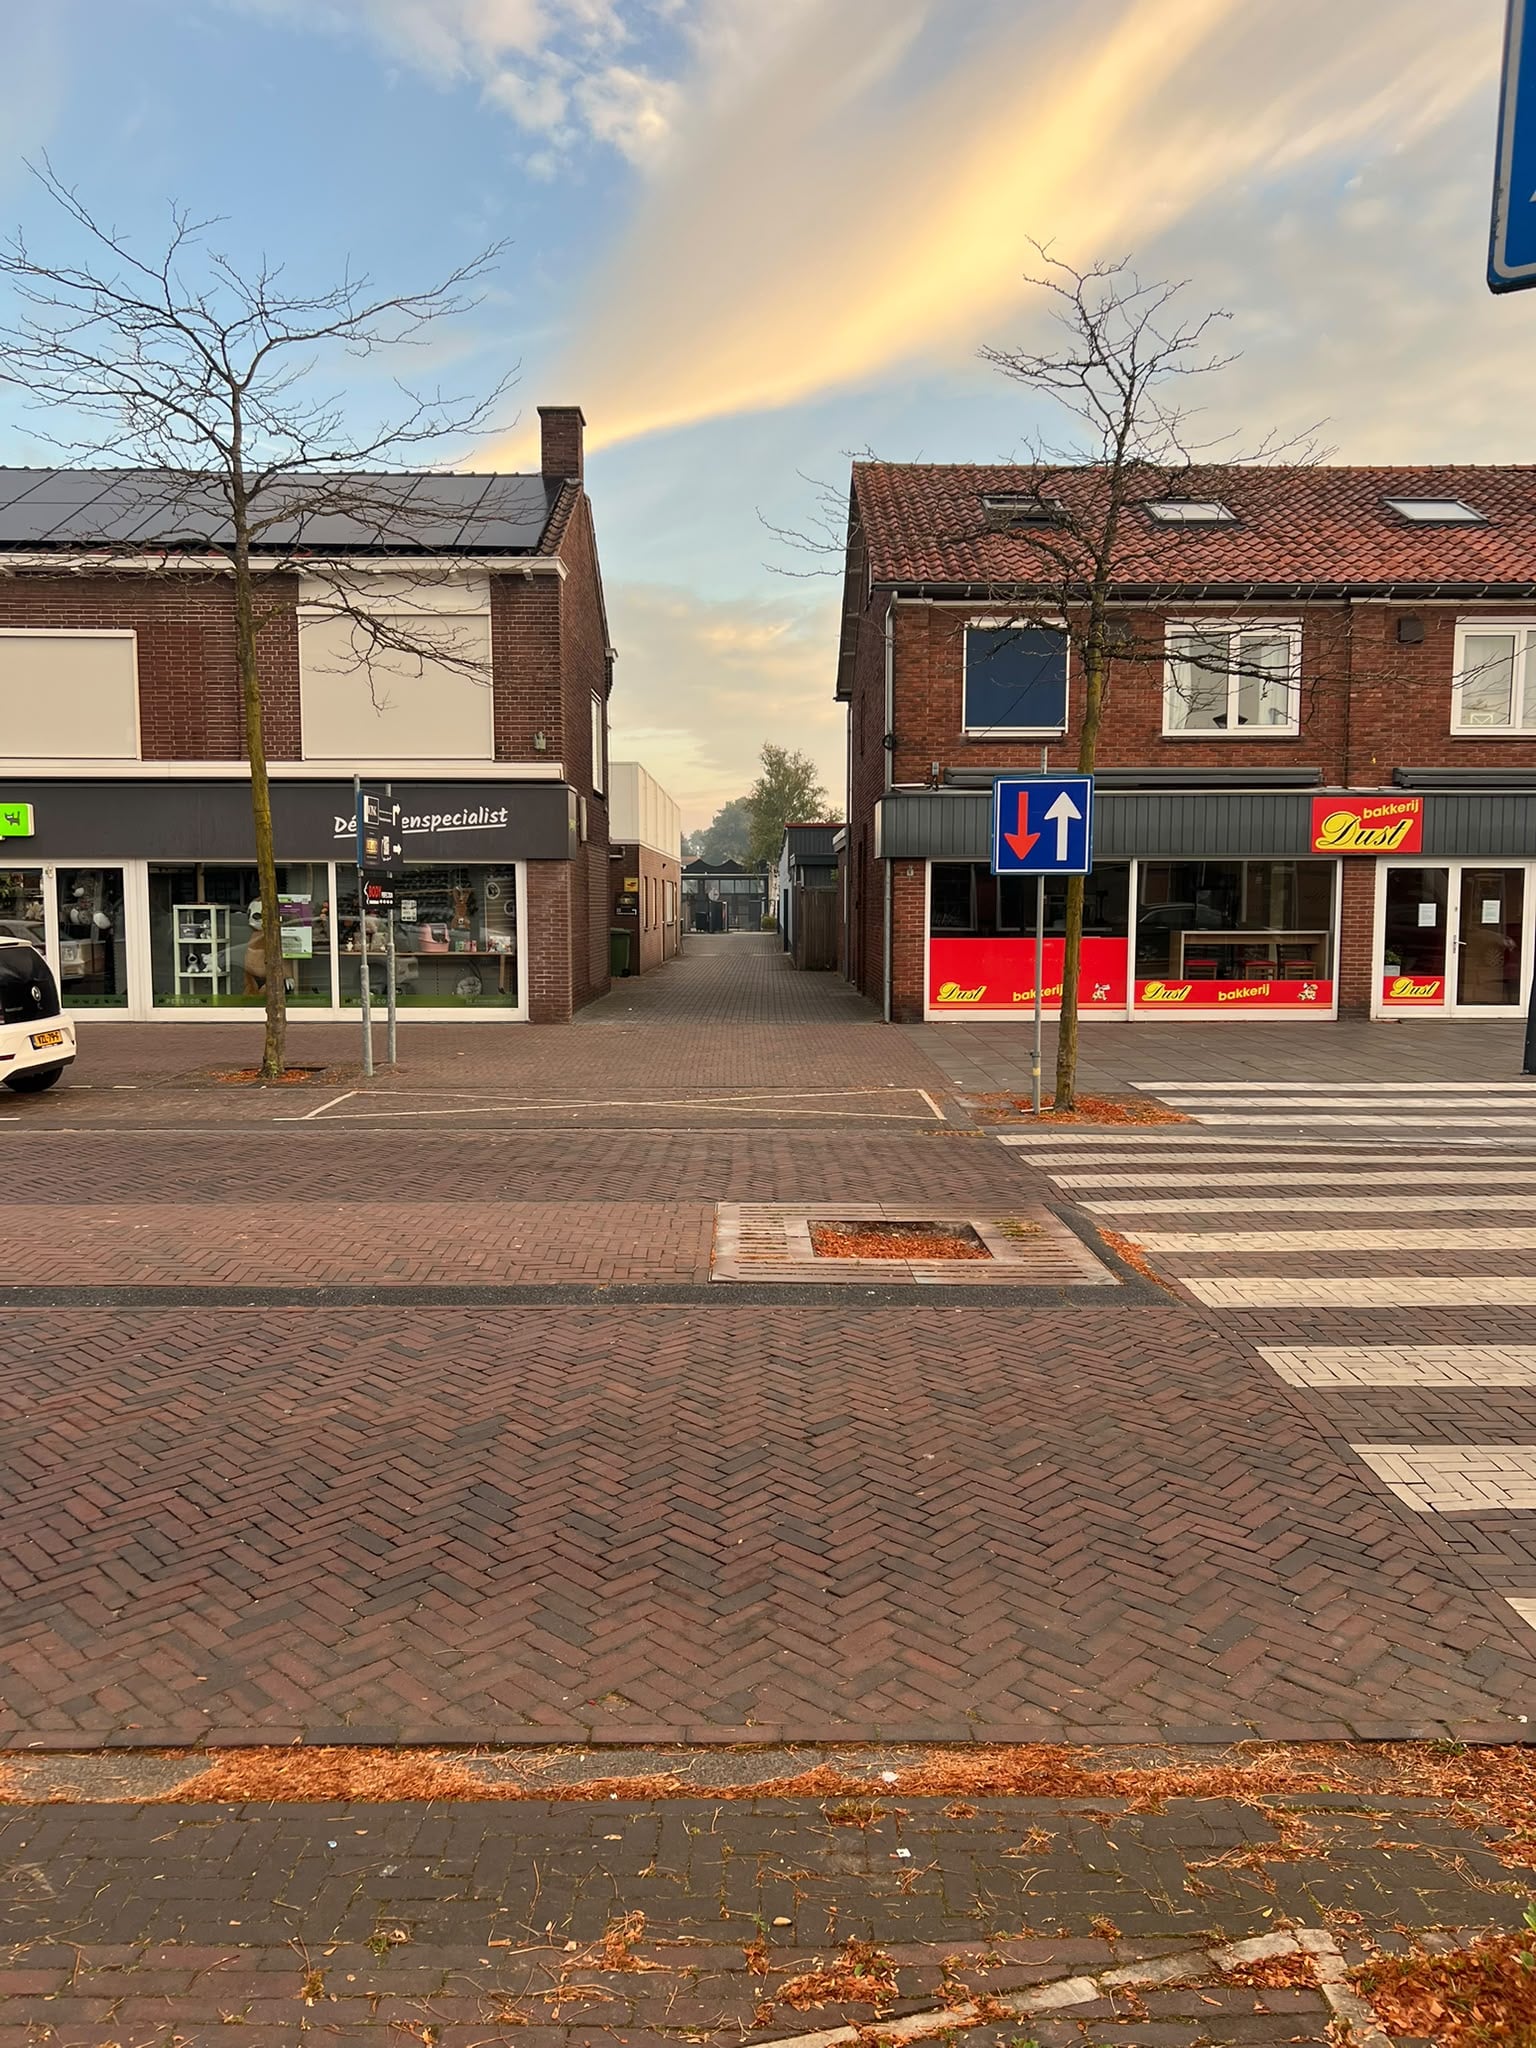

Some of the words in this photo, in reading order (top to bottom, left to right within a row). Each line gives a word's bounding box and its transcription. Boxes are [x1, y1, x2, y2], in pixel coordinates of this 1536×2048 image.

[1363, 799, 1419, 819] bakkerij
[402, 807, 508, 832] enspecialist
[1317, 811, 1408, 846] Dust
[940, 983, 986, 1000] Dust
[1144, 983, 1191, 1000] Dust
[1218, 983, 1270, 1001] bakkerij
[1391, 978, 1439, 996] Dust
